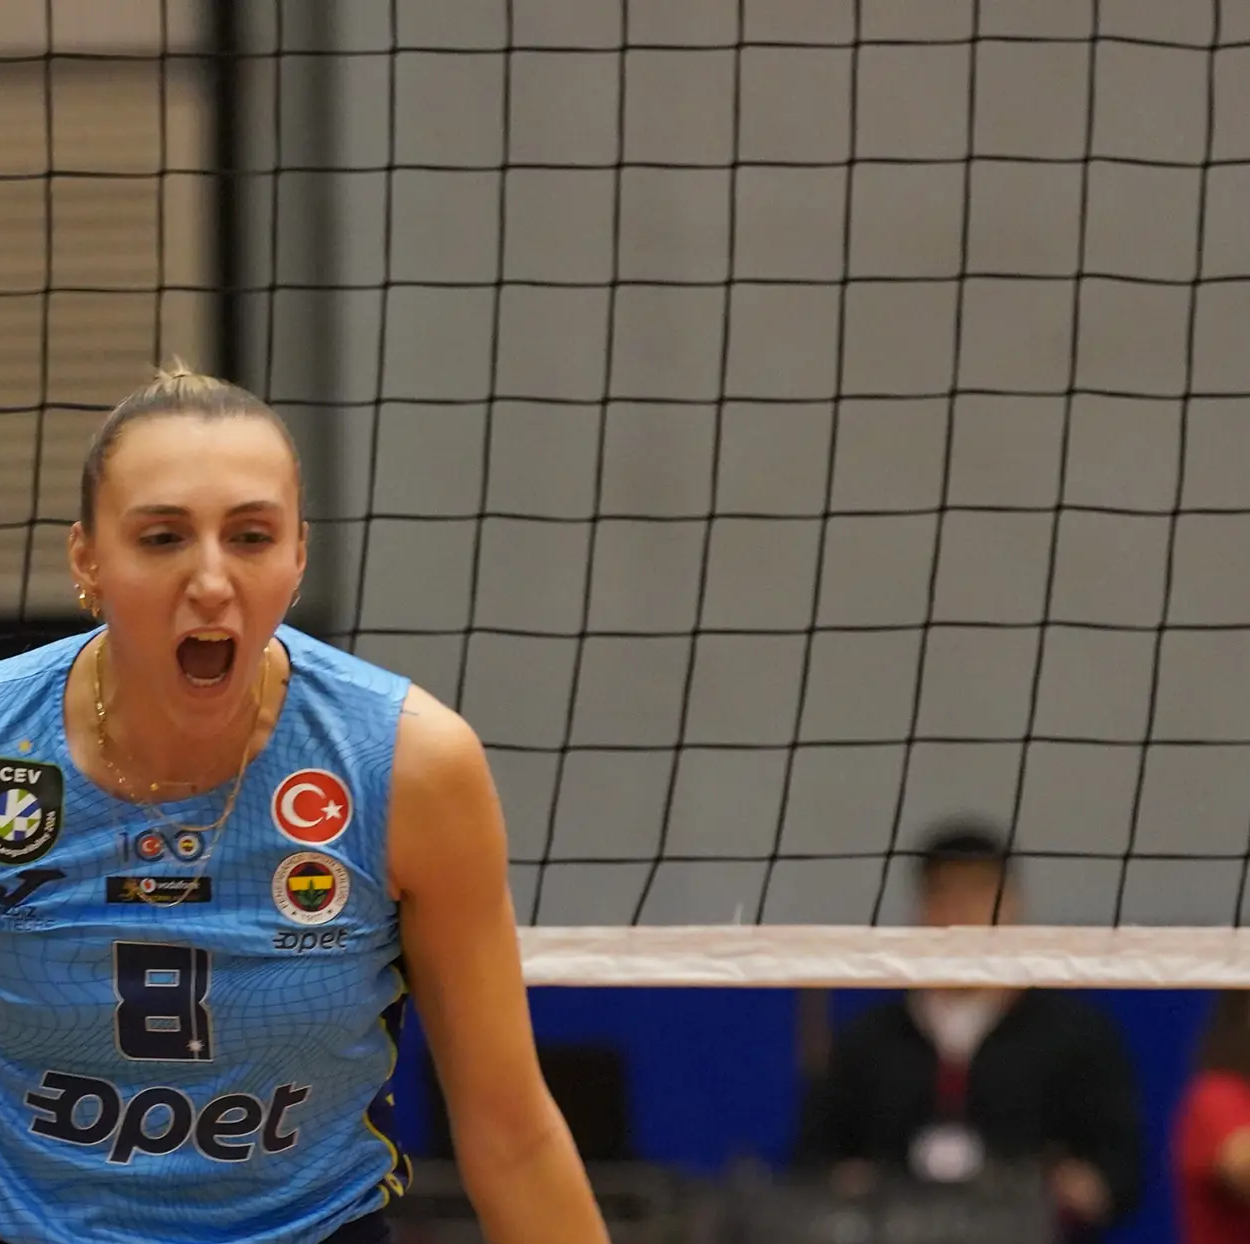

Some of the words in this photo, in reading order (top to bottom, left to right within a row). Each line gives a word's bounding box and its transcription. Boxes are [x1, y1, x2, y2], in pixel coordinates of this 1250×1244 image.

[0, 766, 42, 784] CEV
[272, 928, 348, 953] opet
[112, 940, 214, 1063] 8
[25, 1069, 313, 1165] opet
